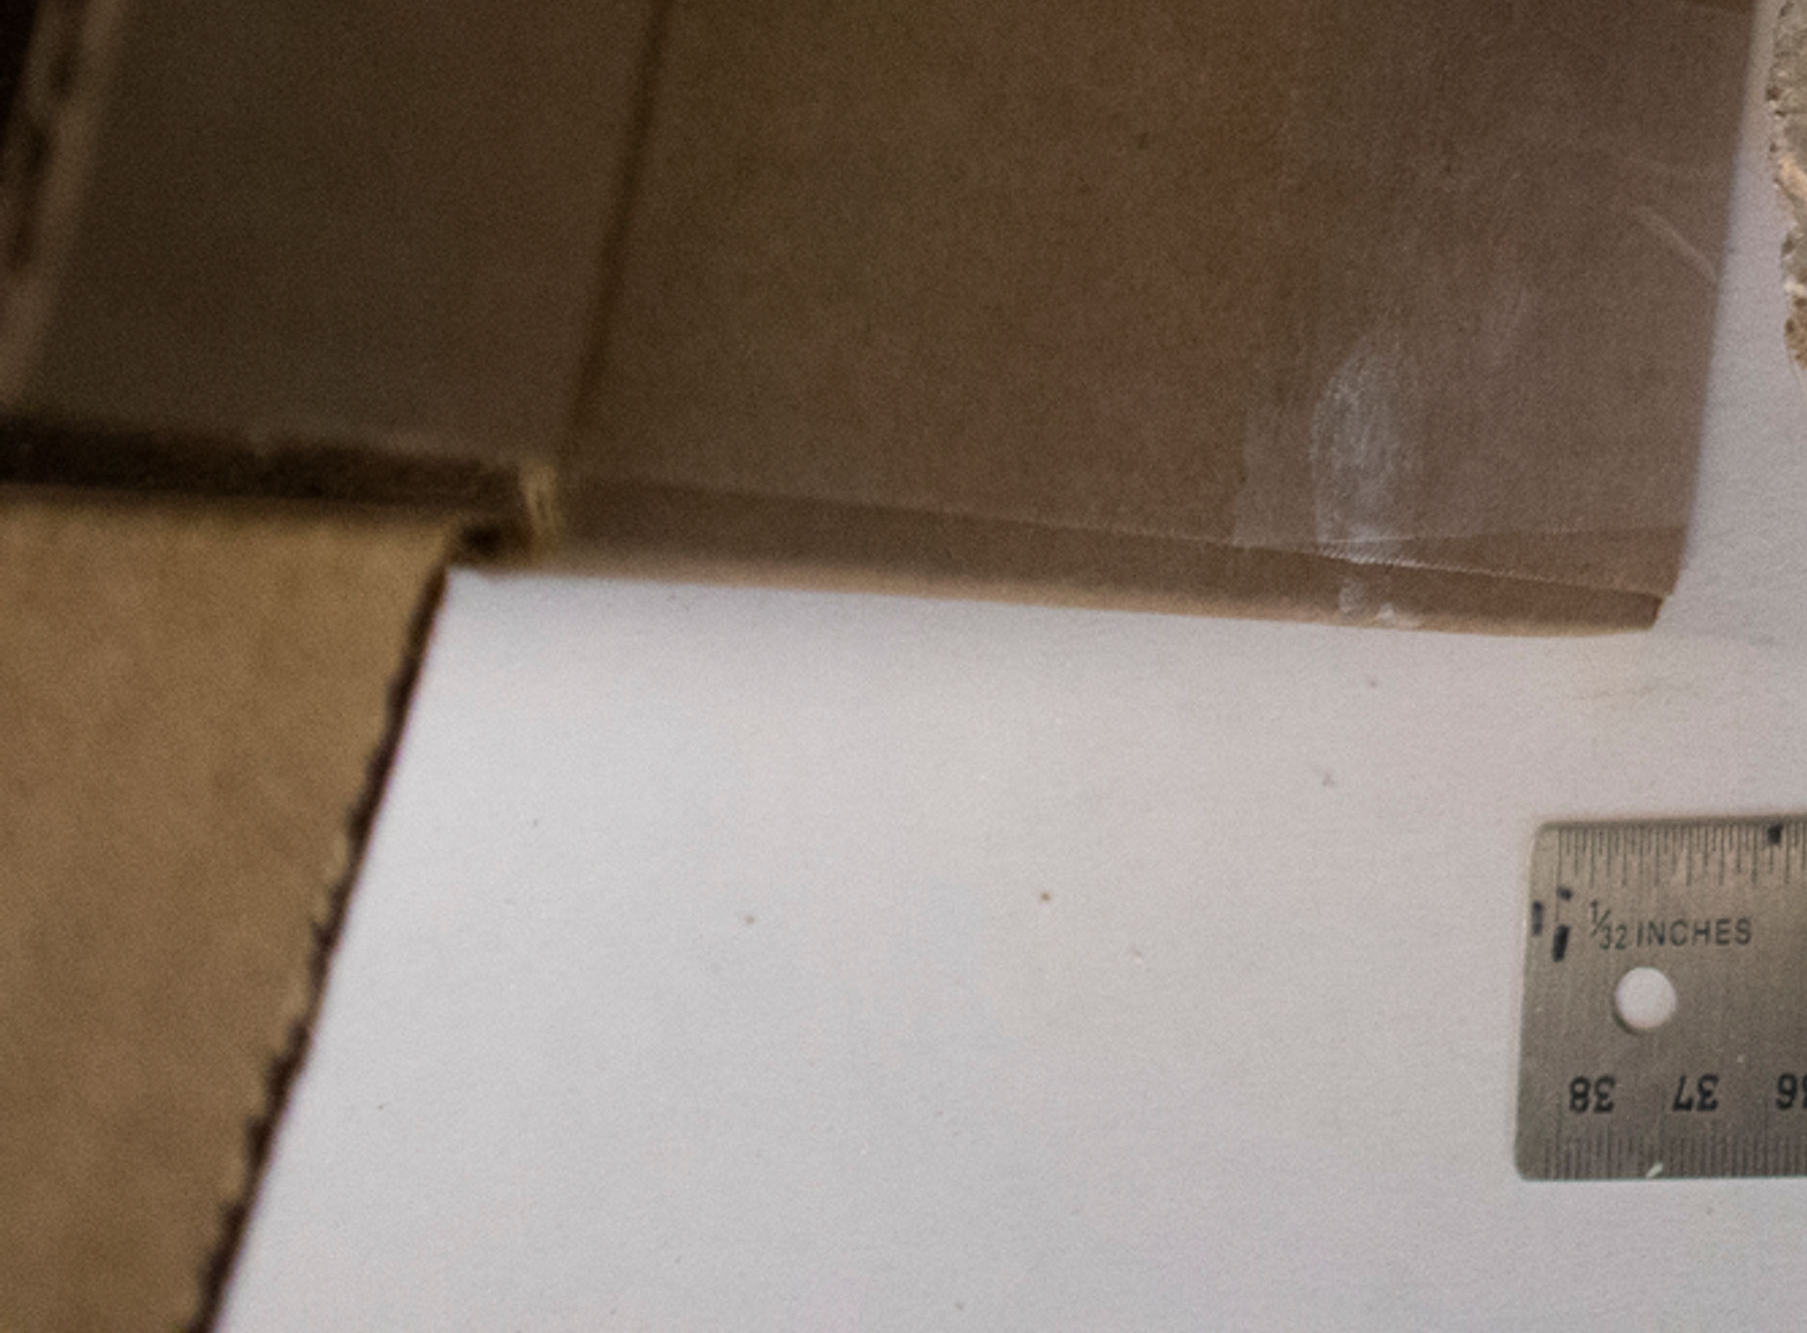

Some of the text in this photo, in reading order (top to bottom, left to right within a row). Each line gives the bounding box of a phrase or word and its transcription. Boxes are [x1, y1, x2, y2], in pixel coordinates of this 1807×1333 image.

[1635, 917, 1752, 947] INCHES
[1567, 1073, 1616, 1115] 38
[1672, 1073, 1720, 1112] 37
